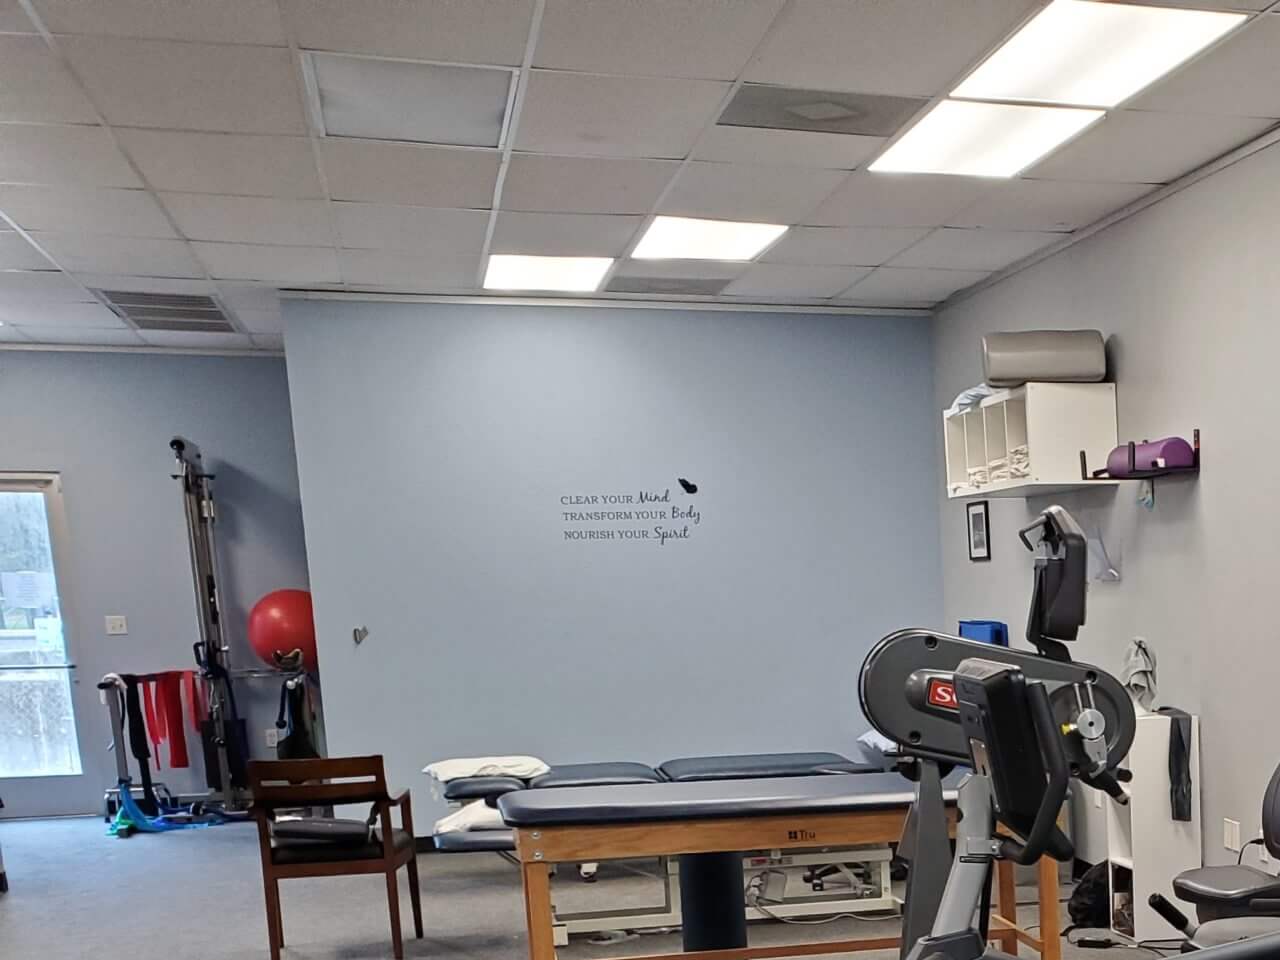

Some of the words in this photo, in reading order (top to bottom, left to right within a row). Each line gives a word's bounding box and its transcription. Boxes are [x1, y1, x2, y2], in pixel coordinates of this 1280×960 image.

[560, 495, 599, 505] CLEAR
[602, 495, 633, 504] YOUR
[636, 489, 671, 504] Mind
[563, 511, 633, 521] TRANSFORM
[634, 510, 667, 520] YOUR
[671, 505, 701, 524] Body
[564, 530, 615, 540] NOURISH
[618, 529, 649, 539] YOUR
[653, 525, 690, 545] Spirit
